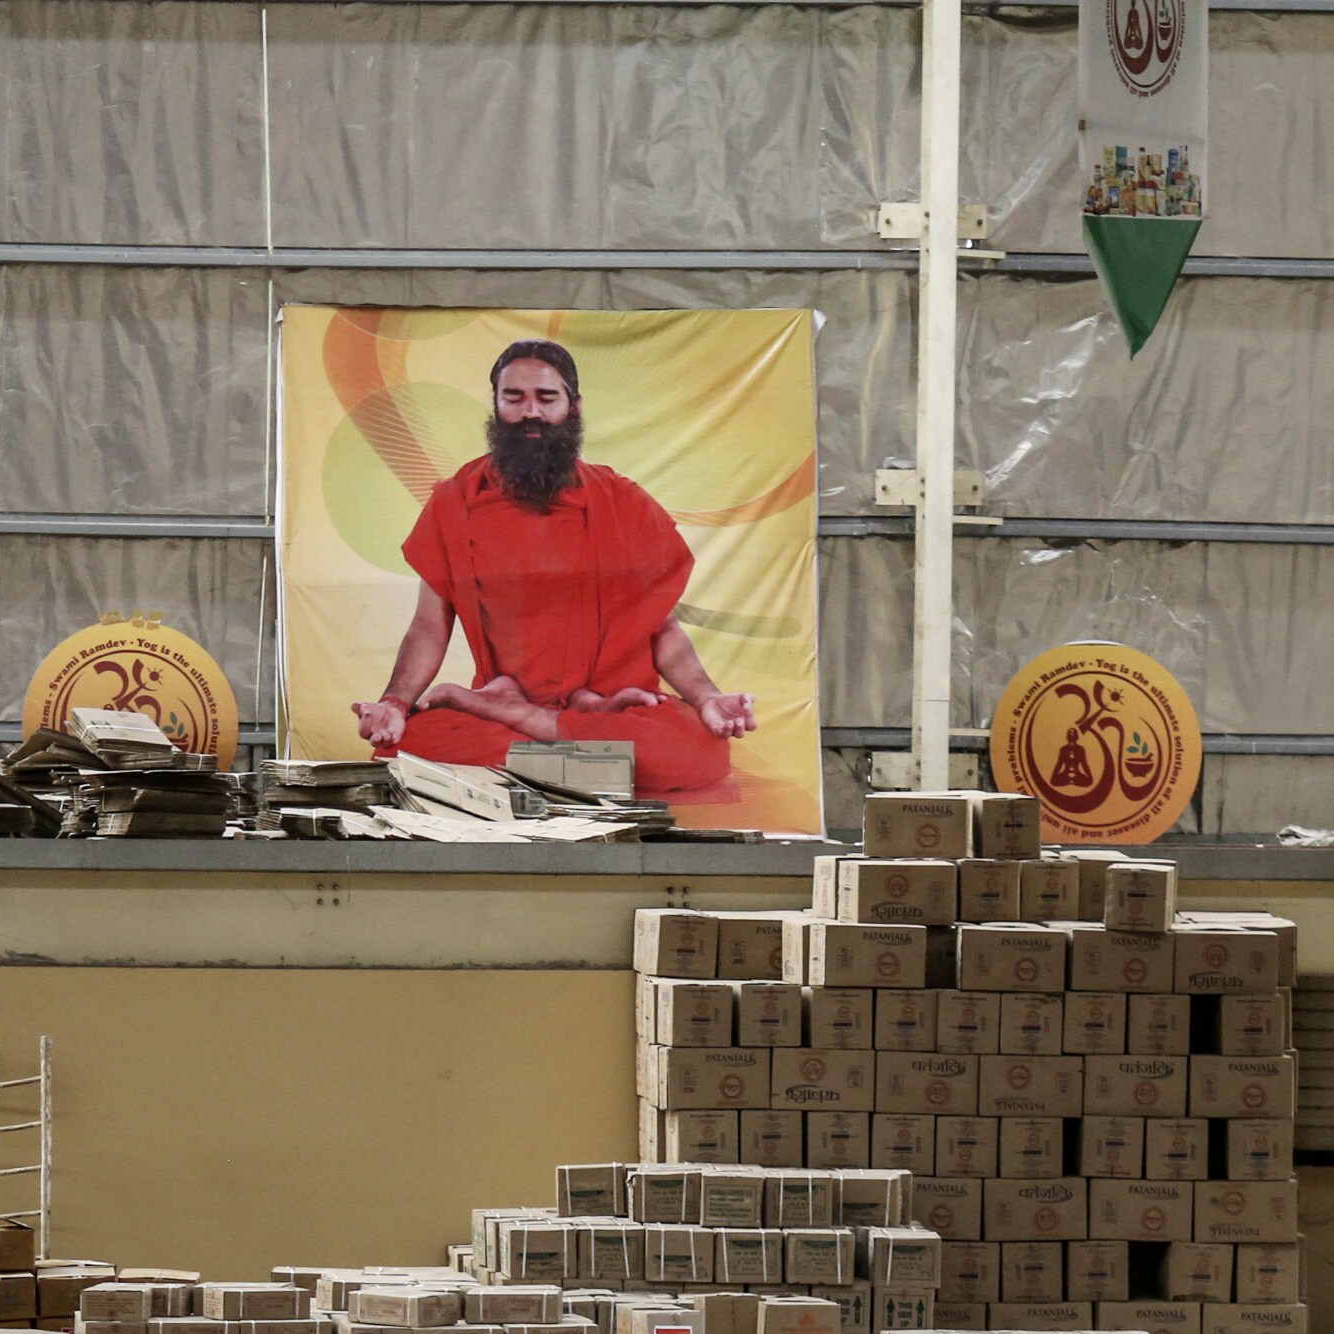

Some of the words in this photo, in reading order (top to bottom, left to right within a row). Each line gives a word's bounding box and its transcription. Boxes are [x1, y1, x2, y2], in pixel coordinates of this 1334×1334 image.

[1040, 659, 1086, 684] Ramdev
[1096, 658, 1117, 673] Yog
[1120, 664, 1130, 675] is
[49, 656, 80, 690] Swami
[80, 639, 127, 659] Ramdev
[137, 638, 158, 652] Yog
[160, 645, 171, 656] is
[172, 652, 190, 669] the
[190, 667, 217, 715] ultimate
[1132, 670, 1149, 687] the
[1013, 680, 1042, 717] Swami
[1149, 685, 1180, 732] ultimate
[1007, 726, 1023, 784] problems
[1168, 735, 1184, 785] solution
[1150, 800, 1165, 815] all
[1062, 825, 1079, 837] all
[1107, 809, 1151, 838] diseases
[1081, 830, 1103, 839] and
[756, 926, 782, 935] PATAN
[935, 1310, 971, 1322] ANJALI
